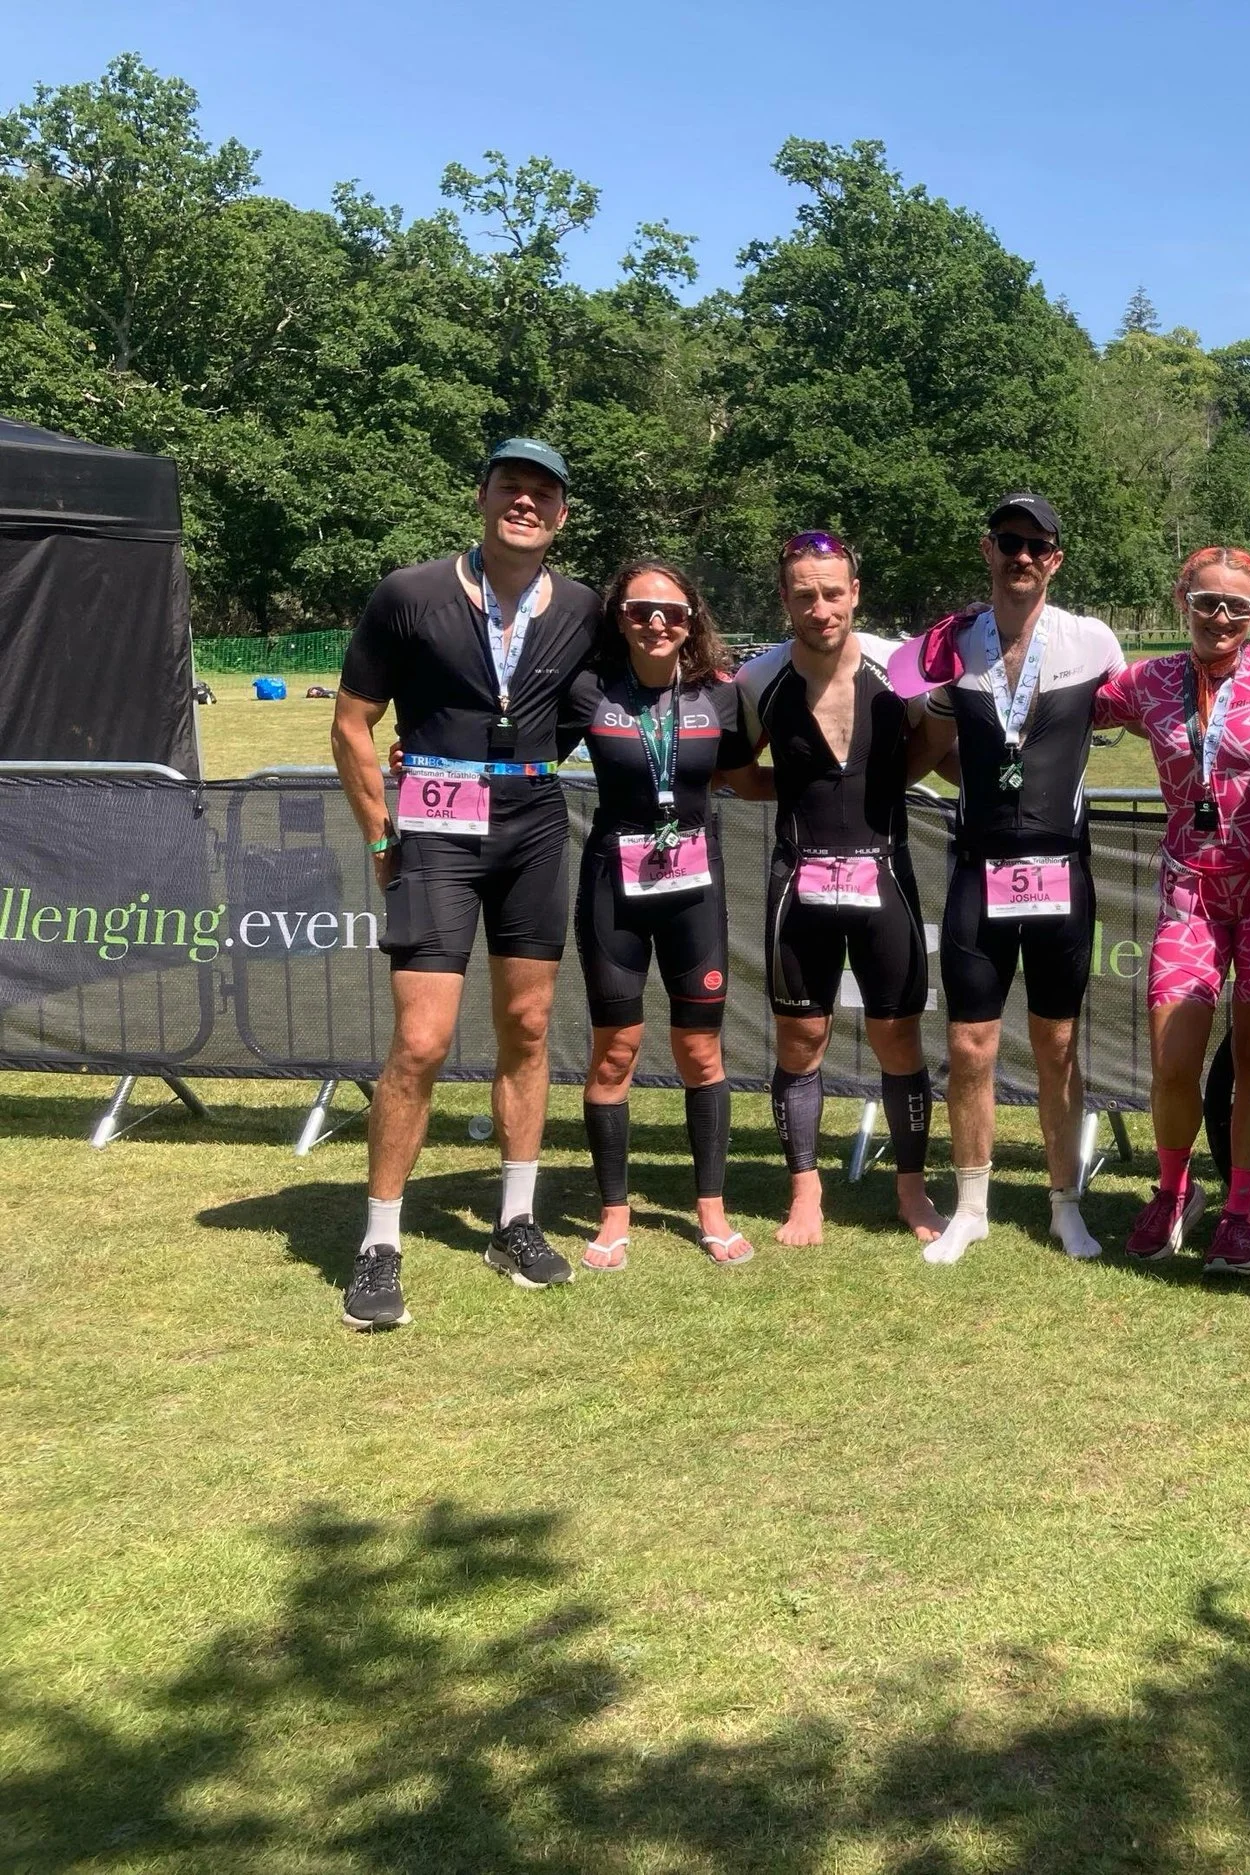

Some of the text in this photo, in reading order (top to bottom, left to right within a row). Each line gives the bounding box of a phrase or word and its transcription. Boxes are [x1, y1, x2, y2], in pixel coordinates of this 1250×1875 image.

[422, 780, 462, 808] 67
[426, 809, 457, 819] CARL
[854, 847, 881, 855] HUUB
[649, 868, 688, 881] LOUISE
[1011, 866, 1043, 893] 51
[821, 883, 861, 893] MARTIN
[1010, 893, 1051, 904] JOSHUA
[0, 887, 388, 963] llenging.even
[775, 997, 811, 1007] HUUB
[908, 1094, 925, 1132] HUUB
